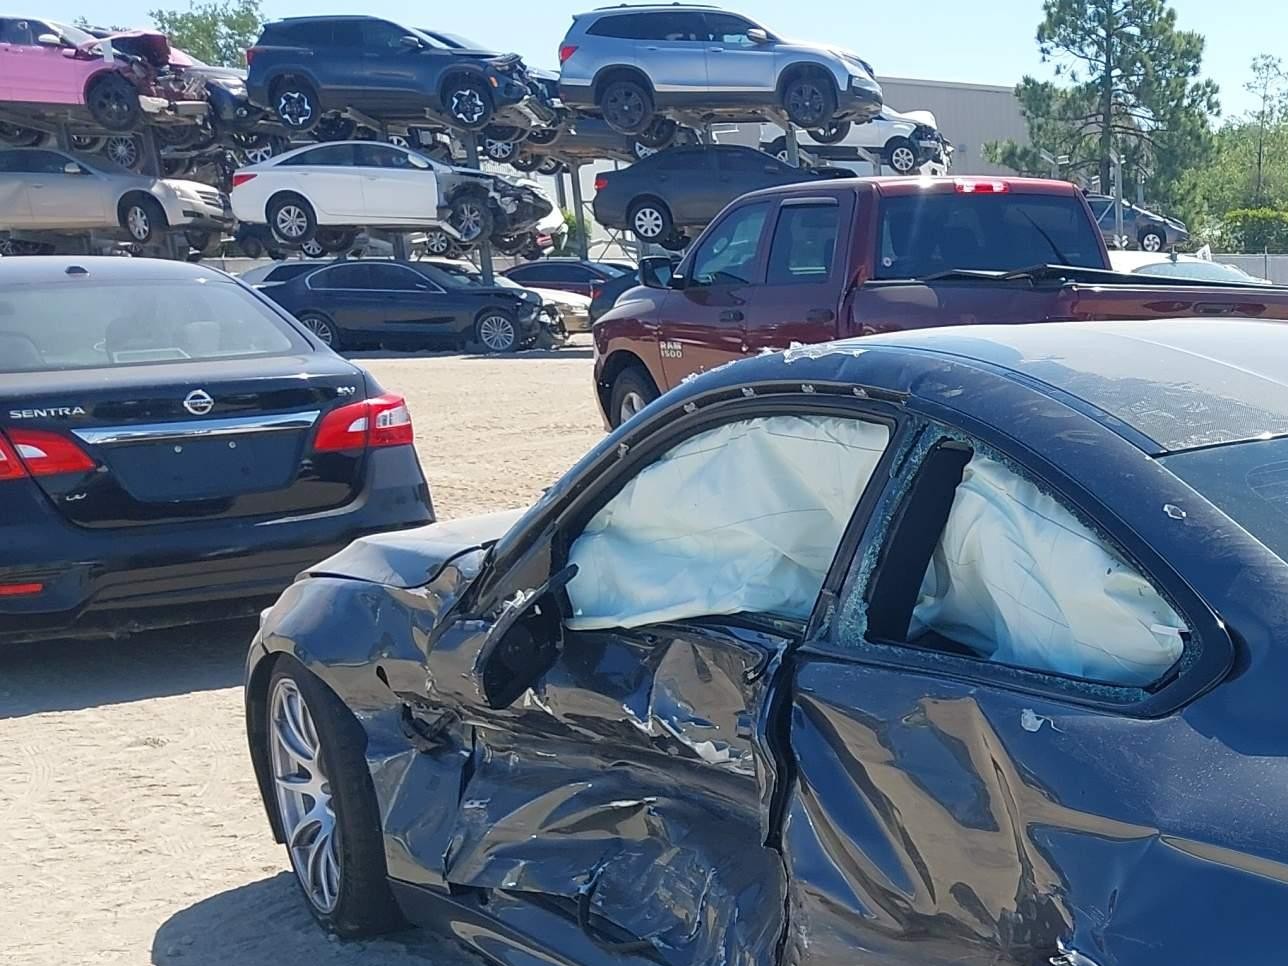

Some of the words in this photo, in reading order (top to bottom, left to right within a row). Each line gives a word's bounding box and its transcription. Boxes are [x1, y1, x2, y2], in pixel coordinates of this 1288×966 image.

[660, 341, 682, 350] RAM
[660, 350, 682, 358] 1500
[9, 406, 86, 419] SENTRA
